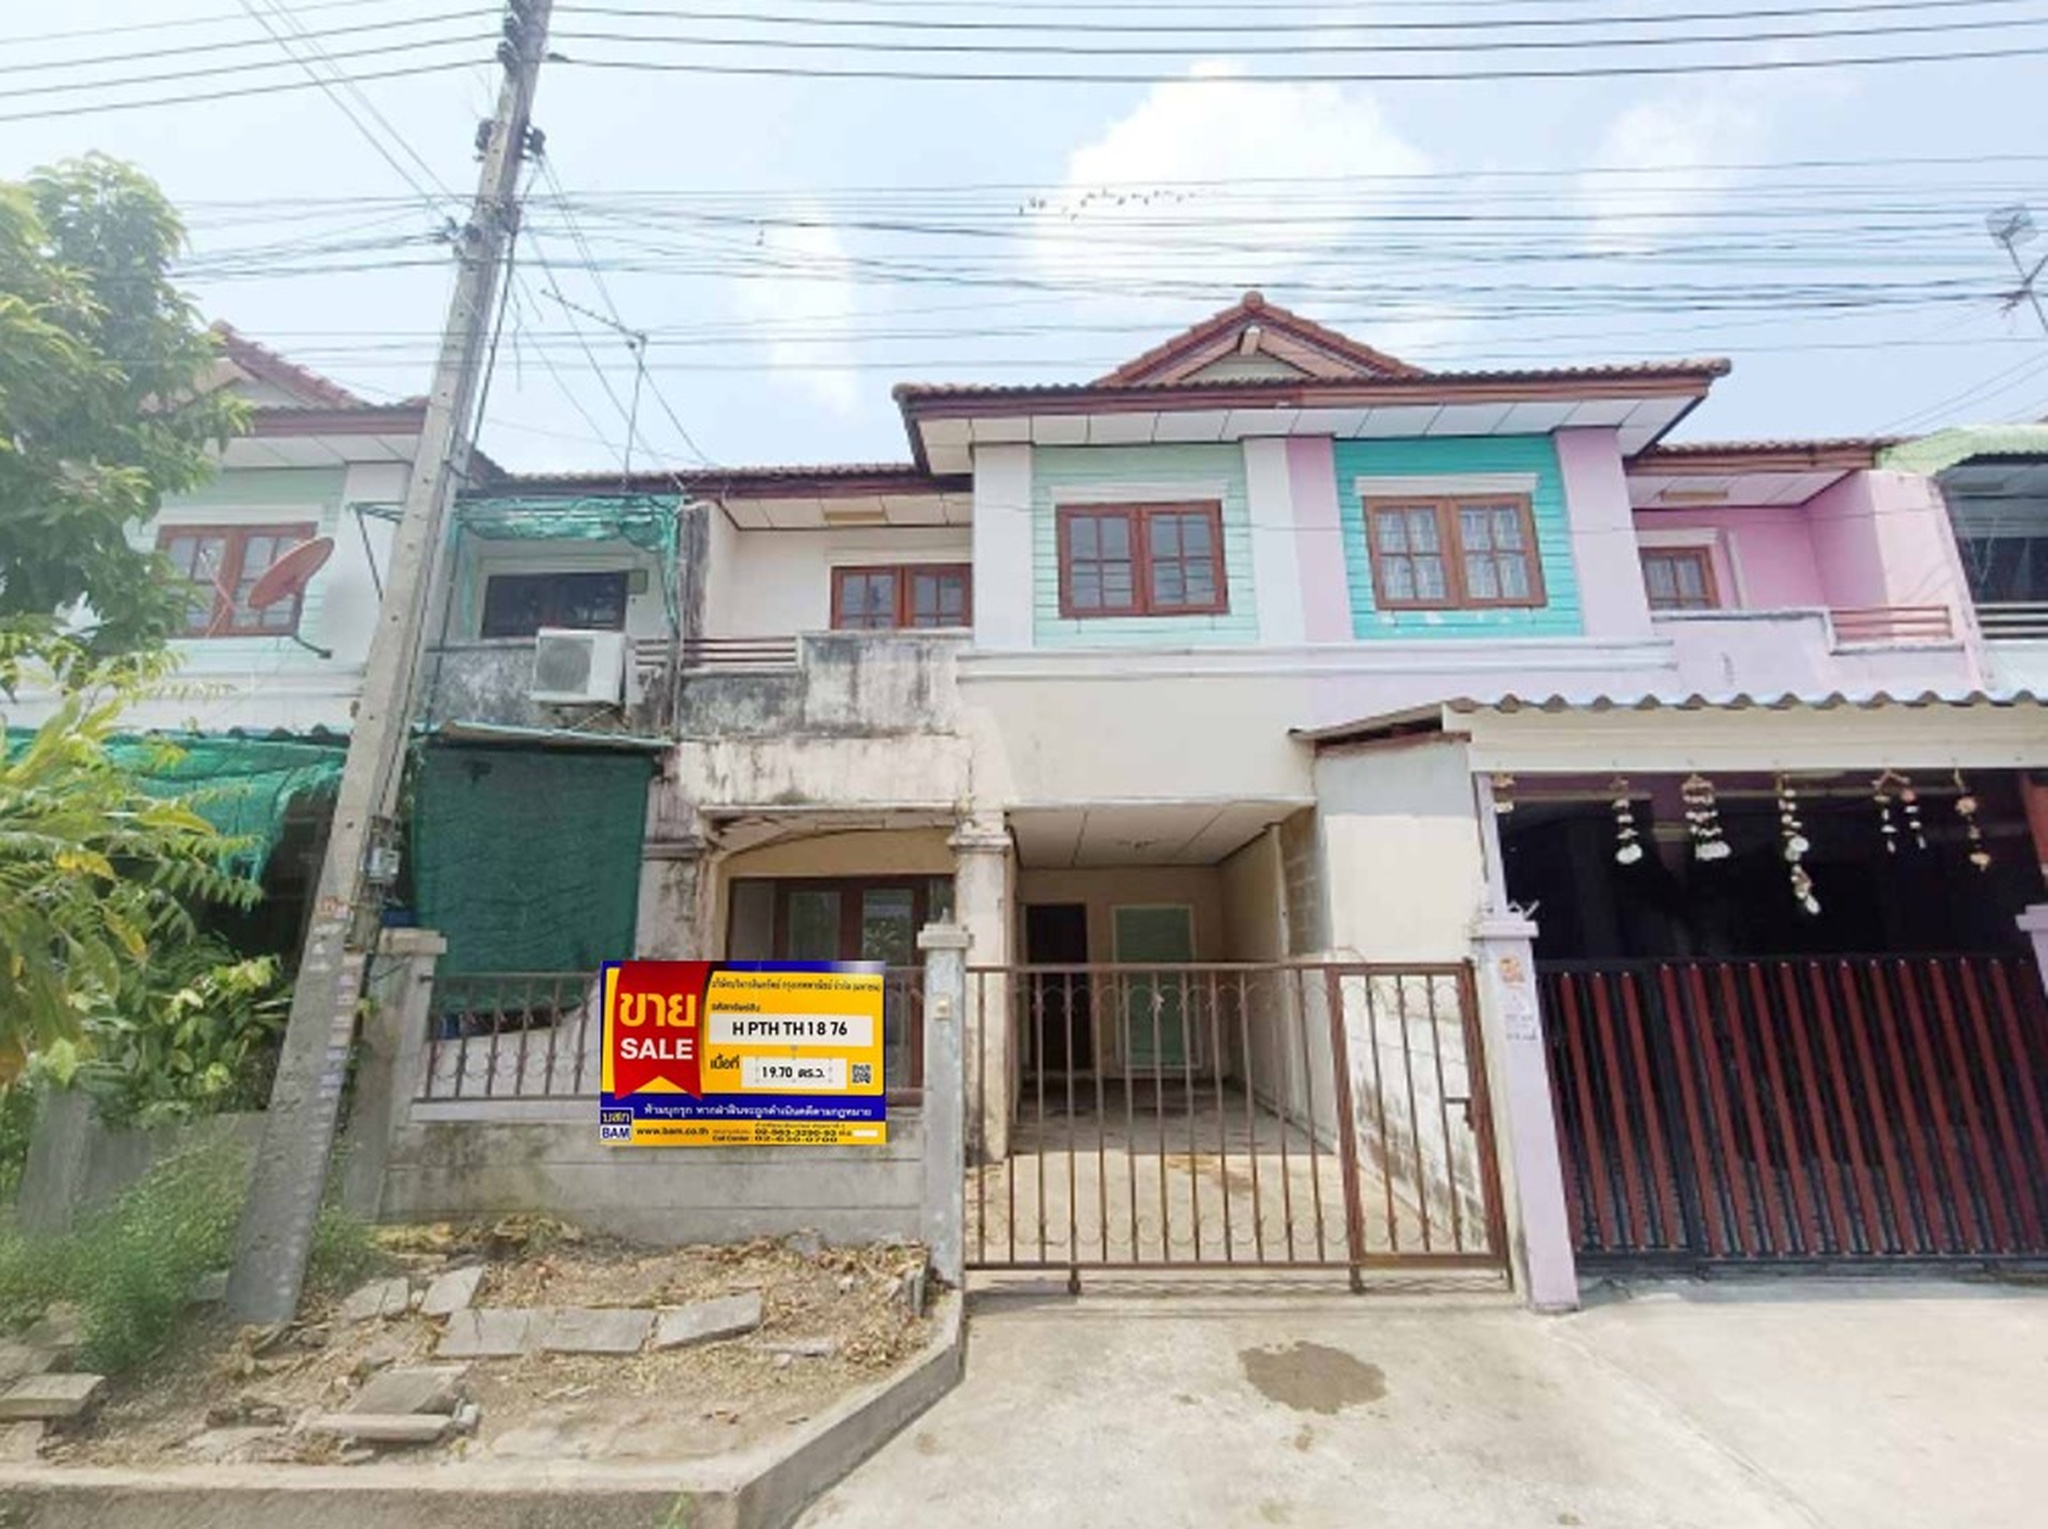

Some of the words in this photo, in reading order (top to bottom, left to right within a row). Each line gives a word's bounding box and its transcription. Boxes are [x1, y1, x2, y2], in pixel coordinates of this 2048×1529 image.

[620, 993, 696, 1027] ขาย
[620, 1037, 693, 1059] SALE
[602, 1127, 630, 1139] BAM
[636, 1126, 709, 1136] www.bam.co.th
